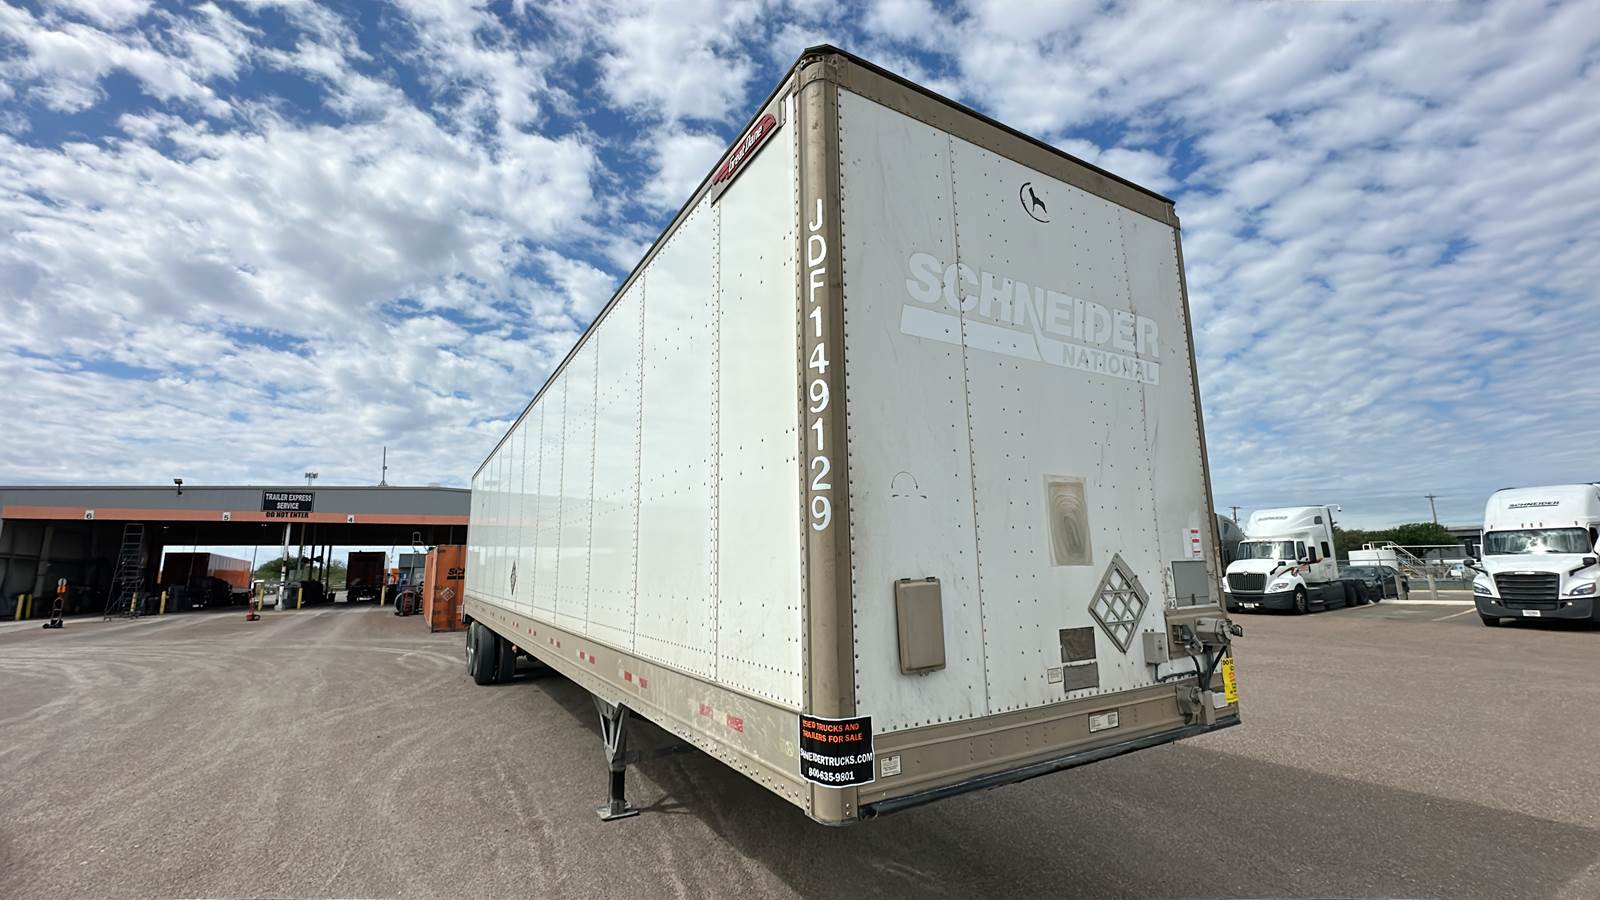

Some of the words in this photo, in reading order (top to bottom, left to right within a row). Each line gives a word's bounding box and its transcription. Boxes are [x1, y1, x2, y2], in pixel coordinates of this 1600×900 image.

[744, 125, 763, 153] Dane
[905, 252, 1160, 358] SCHNEIDER
[808, 198, 832, 532] JDF149129
[1062, 344, 1156, 383] NATIONAL
[265, 493, 288, 501] TRAILER
[288, 494, 312, 502] EXPRESS
[276, 502, 300, 510] SERVICE
[817, 724, 843, 732] TRUCKS
[845, 723, 860, 731] AND
[828, 735, 844, 744] FOR
[845, 733, 863, 742] SALE
[808, 767, 855, 782] 800-635-9801
